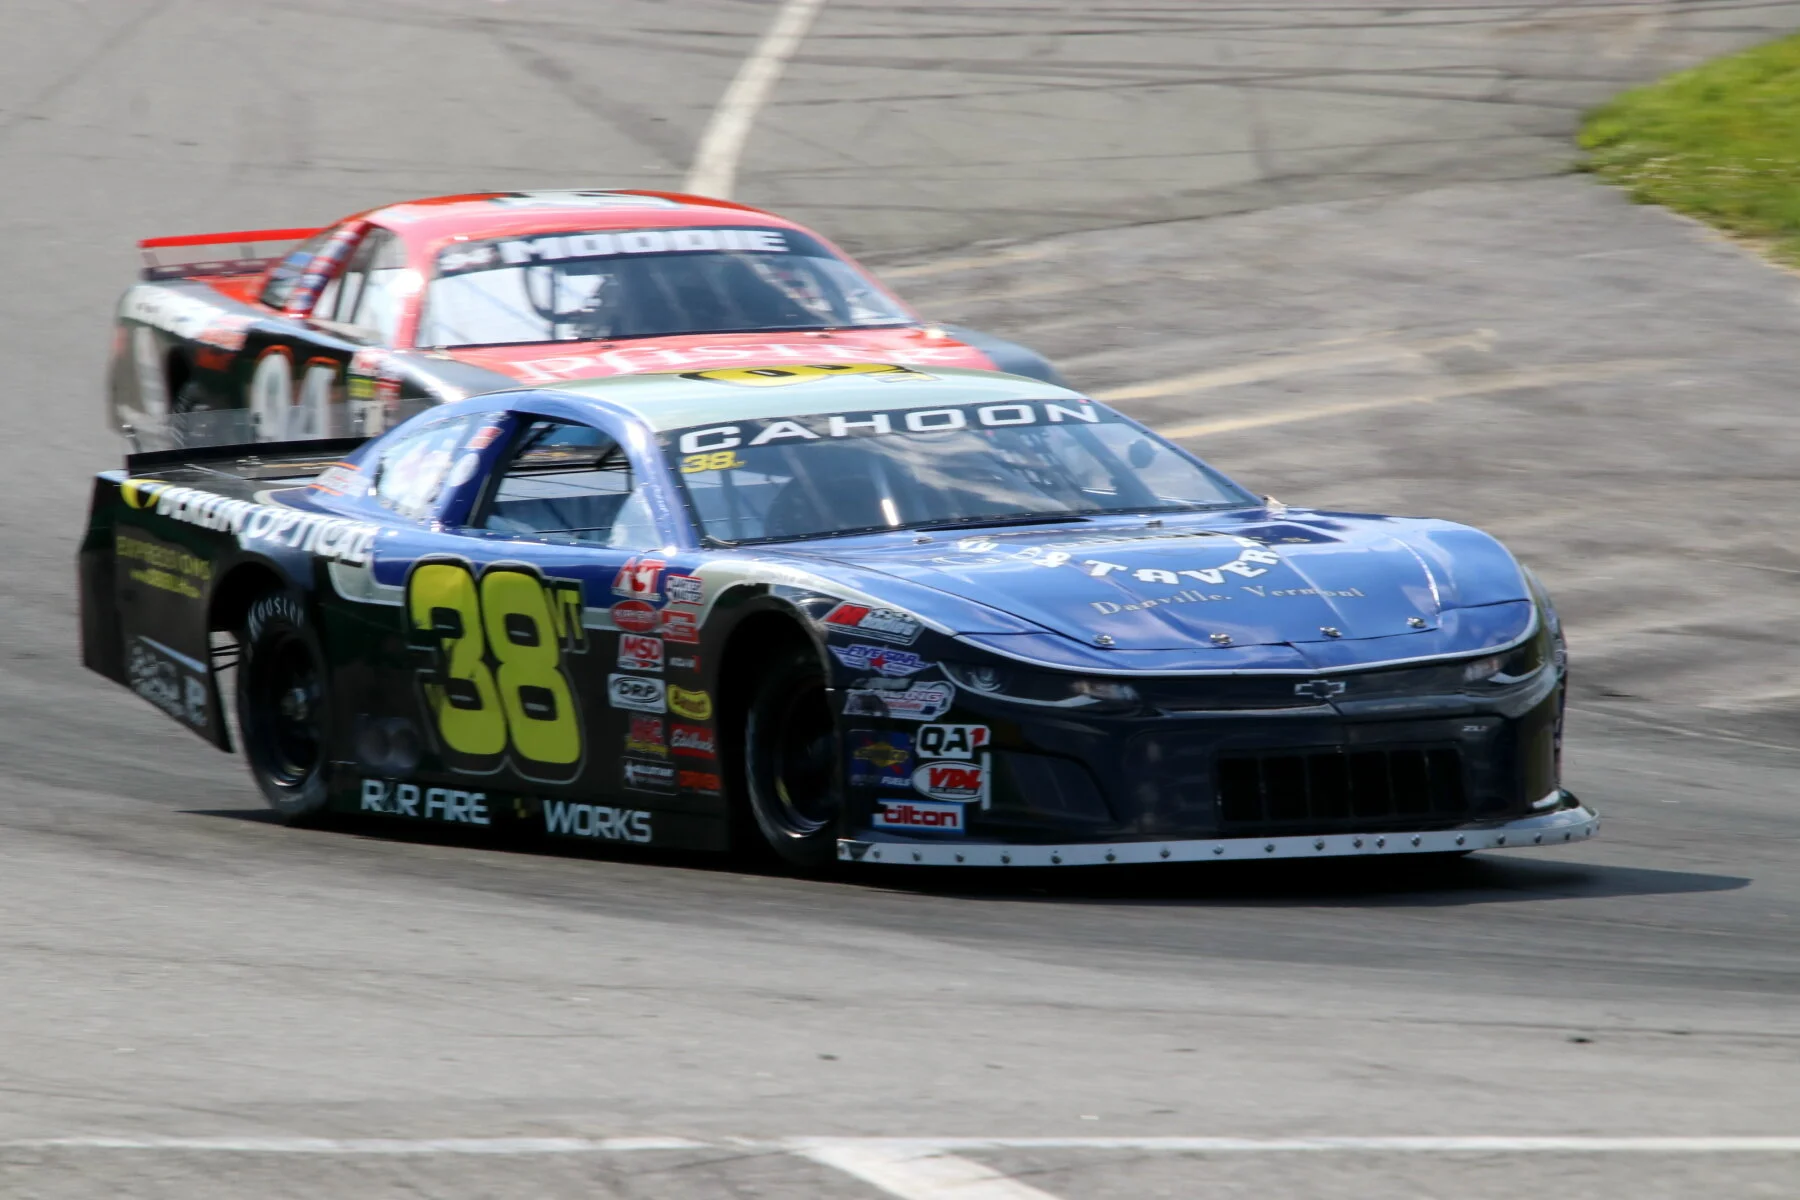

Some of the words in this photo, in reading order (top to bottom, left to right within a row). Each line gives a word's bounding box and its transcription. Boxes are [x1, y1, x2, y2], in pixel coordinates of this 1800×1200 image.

[679, 403, 1100, 454] CAHOON
[406, 556, 584, 774] 38
[920, 726, 986, 757] QA1
[543, 799, 652, 843] WORKS
